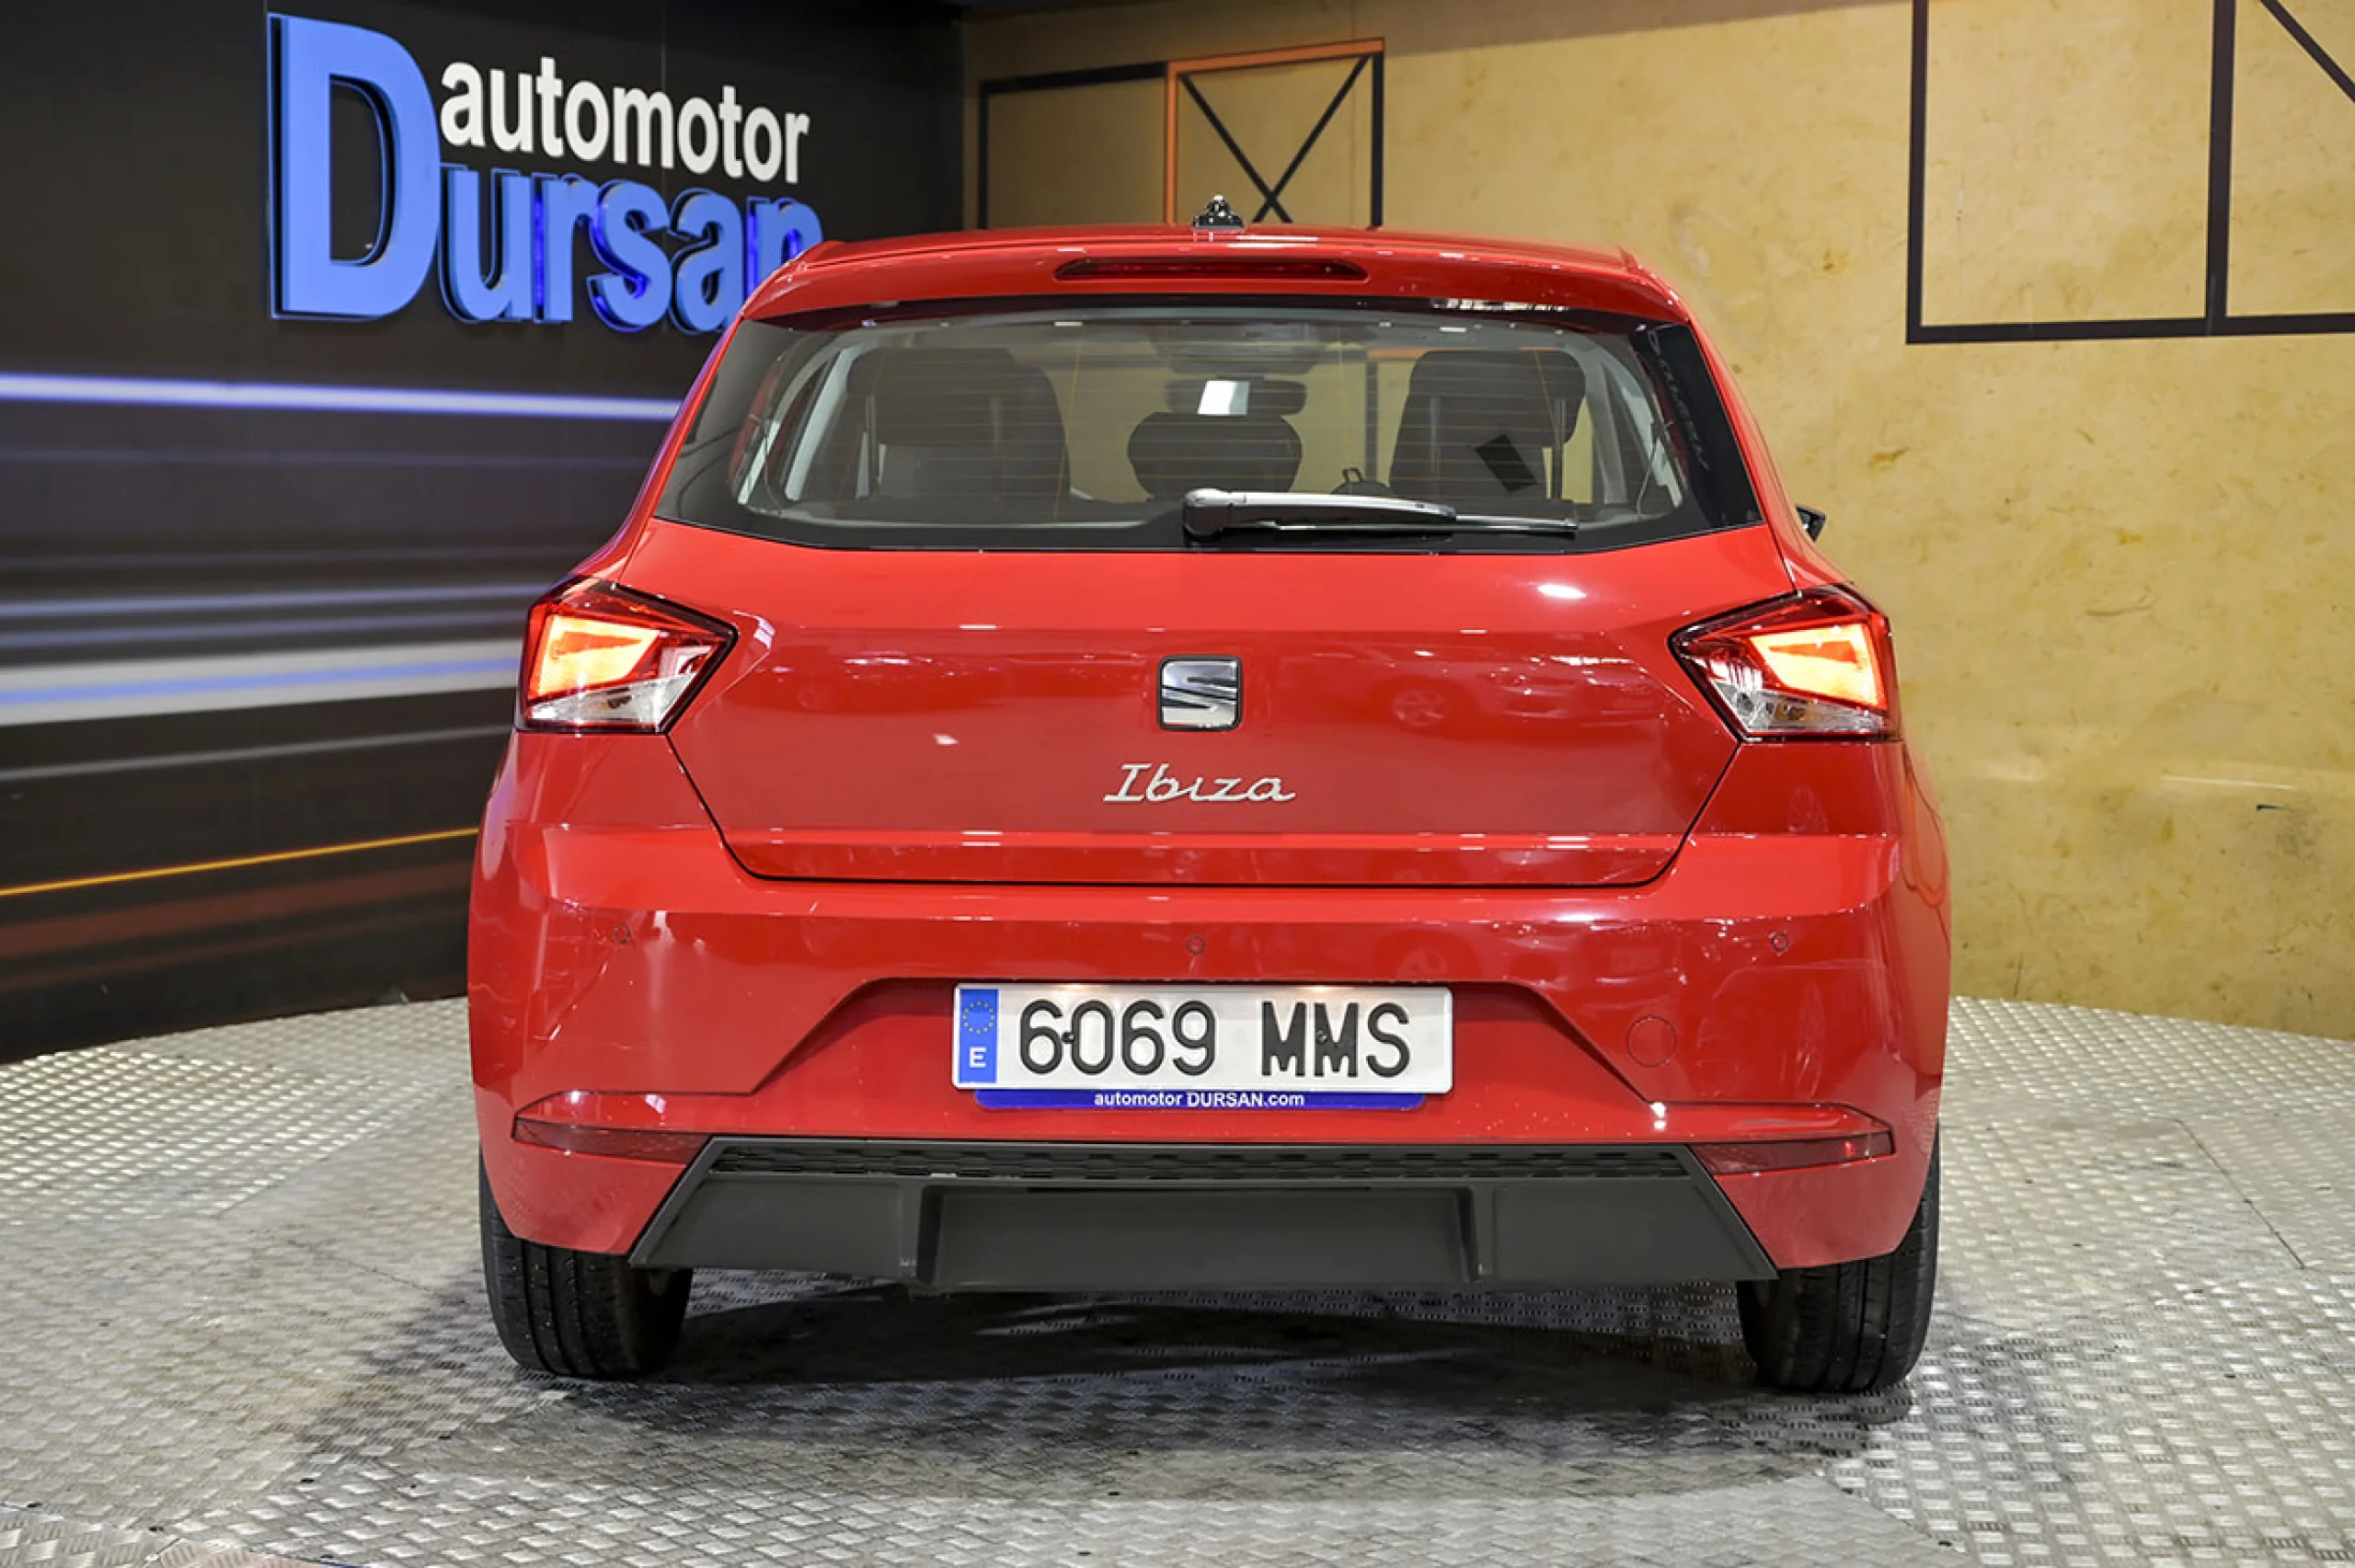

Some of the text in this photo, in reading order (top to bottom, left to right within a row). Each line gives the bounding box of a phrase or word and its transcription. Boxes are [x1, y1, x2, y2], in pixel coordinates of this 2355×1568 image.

[440, 57, 810, 183] automotor
[268, 13, 823, 334] Dursan
[1103, 762, 1296, 802] Ibiza
[969, 1047, 987, 1069] E
[1019, 999, 1410, 1078] 6069 MMS
[1094, 1091, 1304, 1108] automotor DURSAN.com
